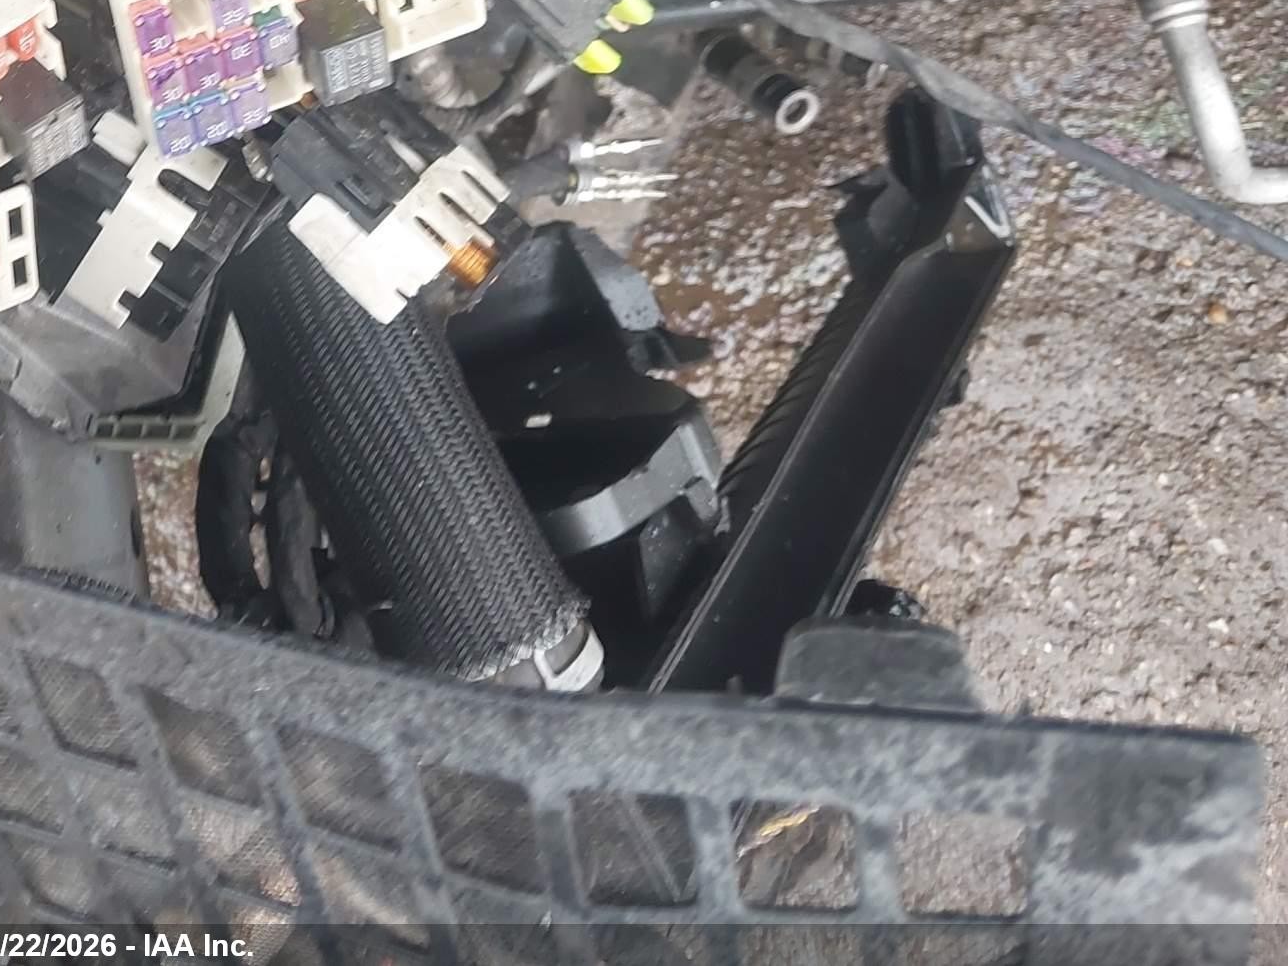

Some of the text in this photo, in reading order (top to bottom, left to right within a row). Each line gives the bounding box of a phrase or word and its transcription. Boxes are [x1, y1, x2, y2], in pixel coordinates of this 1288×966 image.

[223, 7, 245, 25] 25
[150, 34, 171, 52] 30
[231, 43, 254, 60] 30
[200, 72, 220, 89] 30
[162, 87, 183, 104] 30
[243, 107, 263, 124] 25
[207, 121, 228, 138] 20
[170, 135, 192, 153] 20
